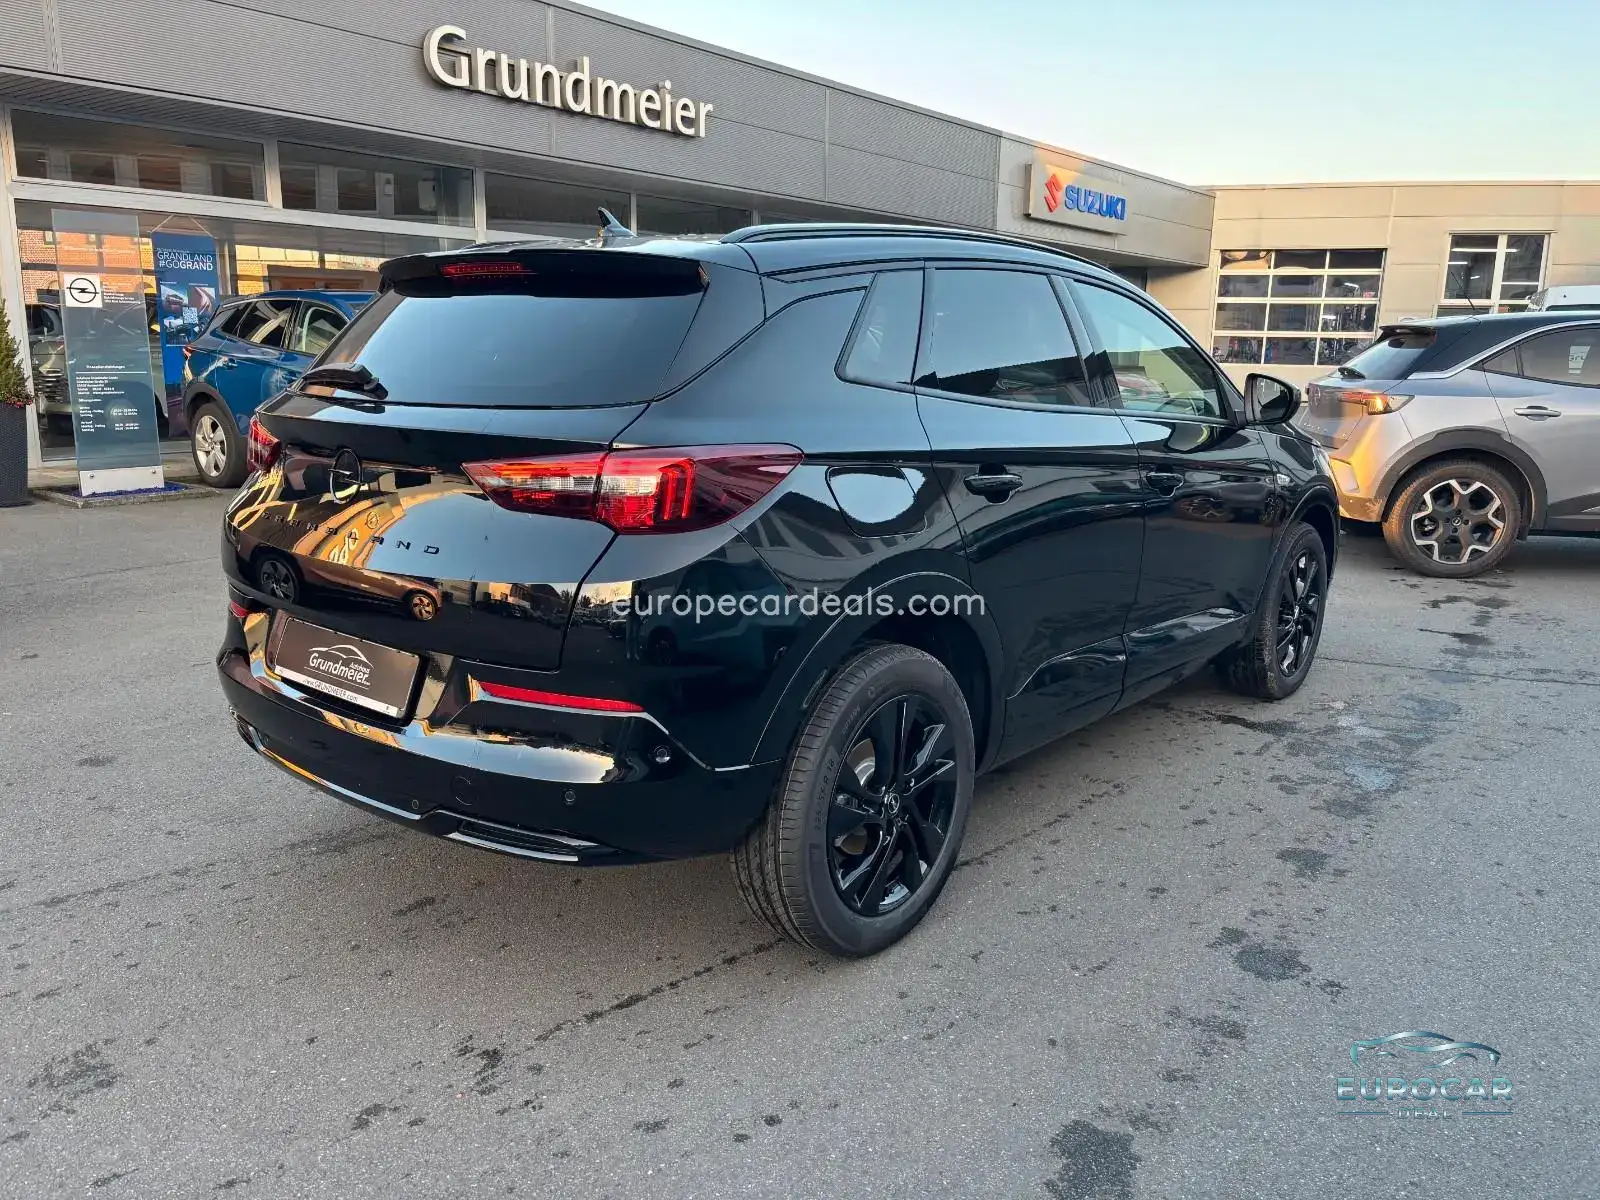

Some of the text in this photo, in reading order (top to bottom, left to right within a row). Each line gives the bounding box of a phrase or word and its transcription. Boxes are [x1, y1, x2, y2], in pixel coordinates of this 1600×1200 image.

[423, 25, 713, 137] Grundmeier
[1065, 185, 1127, 220] SUZUKI
[157, 251, 213, 262] GRANDLAND
[159, 259, 213, 270] #GOGRAND
[309, 652, 369, 683] Grundmeier
